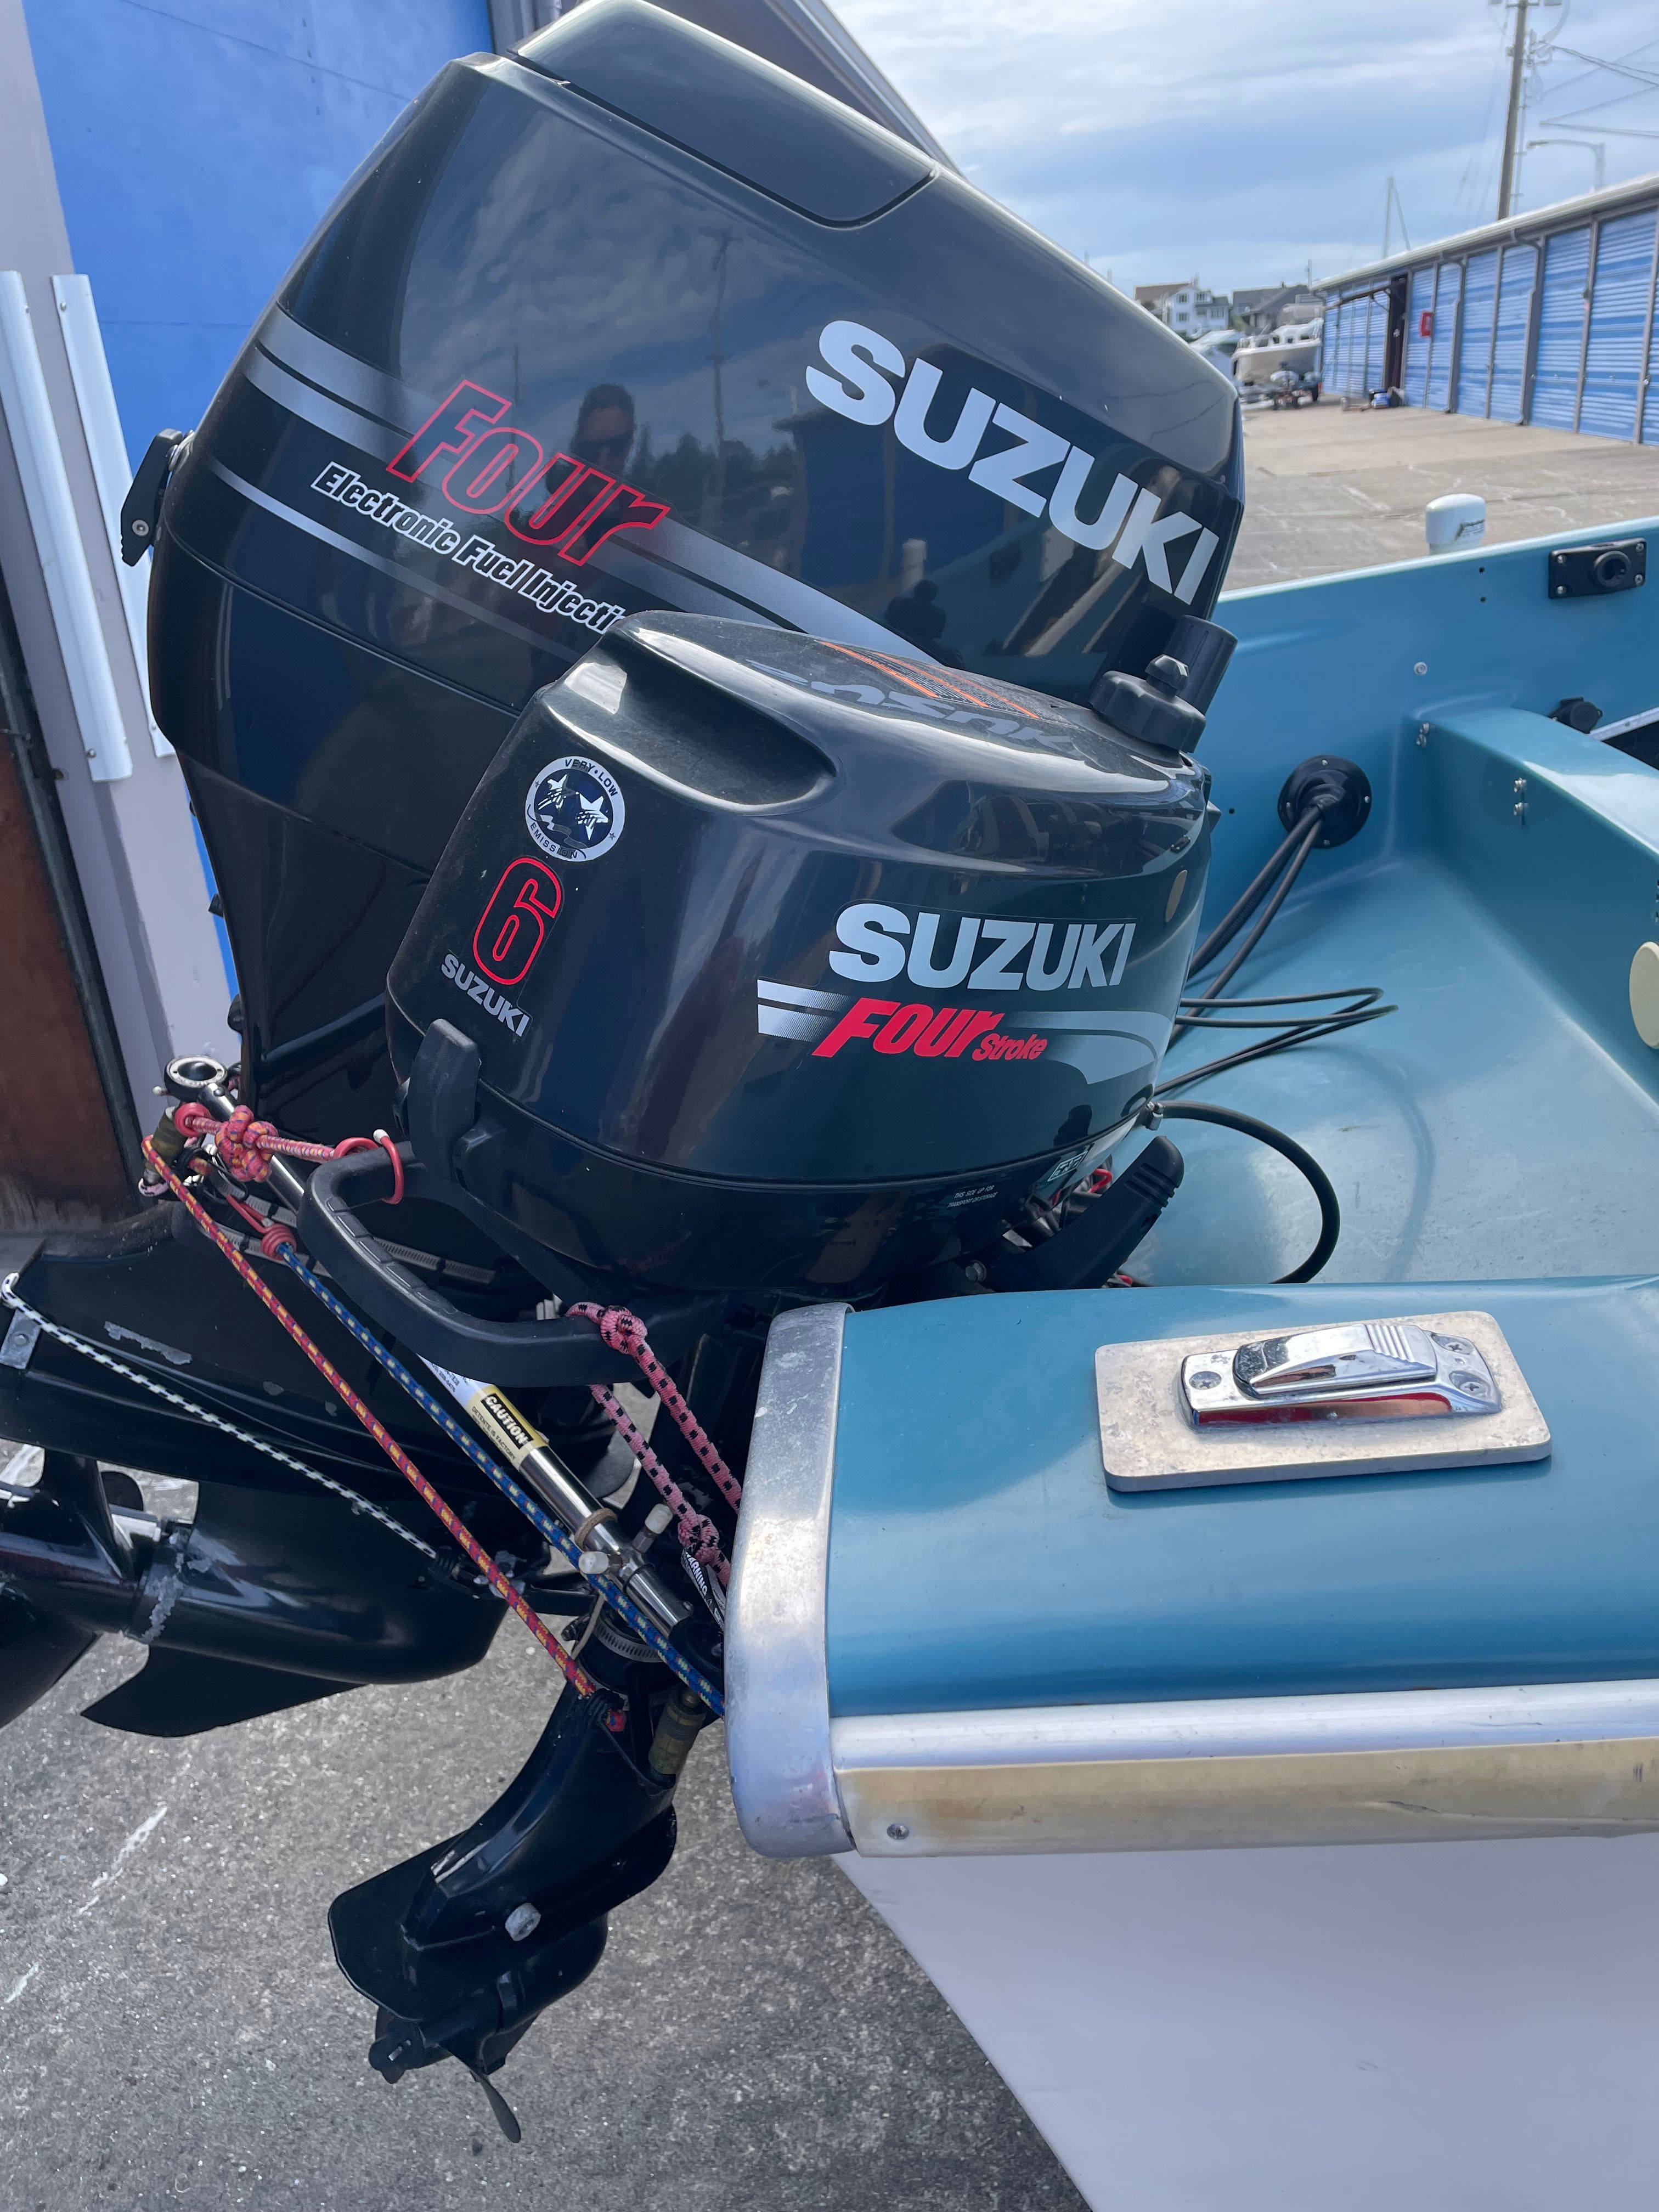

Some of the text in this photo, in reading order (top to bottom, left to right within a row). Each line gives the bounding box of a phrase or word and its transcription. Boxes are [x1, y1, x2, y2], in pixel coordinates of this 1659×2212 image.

[806, 320, 1219, 605] SUZUKI
[311, 461, 461, 554] Electronic
[452, 535, 534, 589] Fuel
[565, 759, 618, 797] VERY LOW
[530, 822, 578, 859] EMISSION
[473, 857, 561, 985] 6
[829, 903, 1136, 991] SUZUKI
[441, 954, 530, 1037] SUZUKI
[972, 1033, 1047, 1062] Stroke
[486, 1396, 529, 1444] CAUTION
